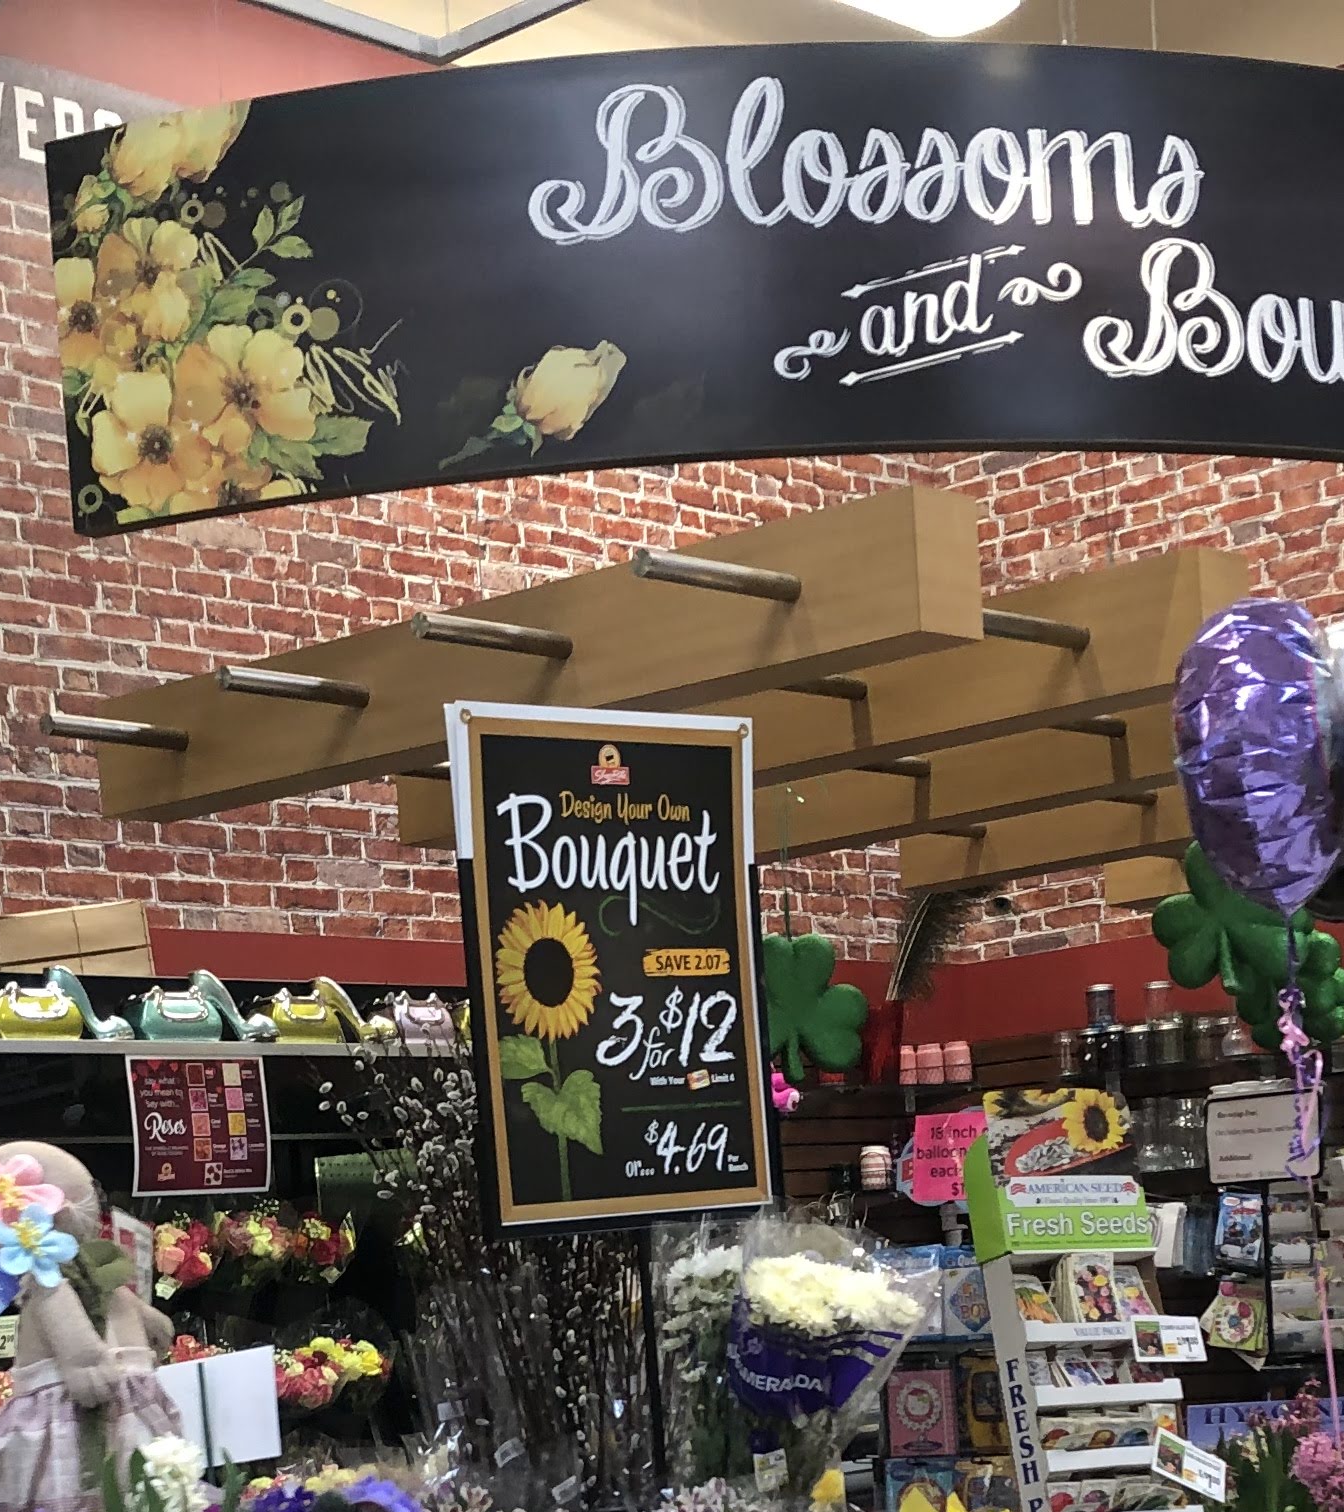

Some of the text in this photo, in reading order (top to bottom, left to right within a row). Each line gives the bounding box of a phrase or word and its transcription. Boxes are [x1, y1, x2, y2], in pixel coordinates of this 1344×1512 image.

[527, 76, 1207, 246] Blossoms
[859, 253, 994, 358] and
[559, 790, 691, 826] Design Your Own
[496, 792, 721, 927] Bouquet
[655, 955, 722, 970] SAVE 2.07
[596, 985, 738, 1081] 3 for $12
[144, 1112, 187, 1143] Roses
[644, 1119, 729, 1175] $4.69
[1027, 1181, 1123, 1194] AMERICAN SEED
[1006, 1210, 1149, 1237] Fresh Seeds
[1005, 1357, 1040, 1485] FRESH
